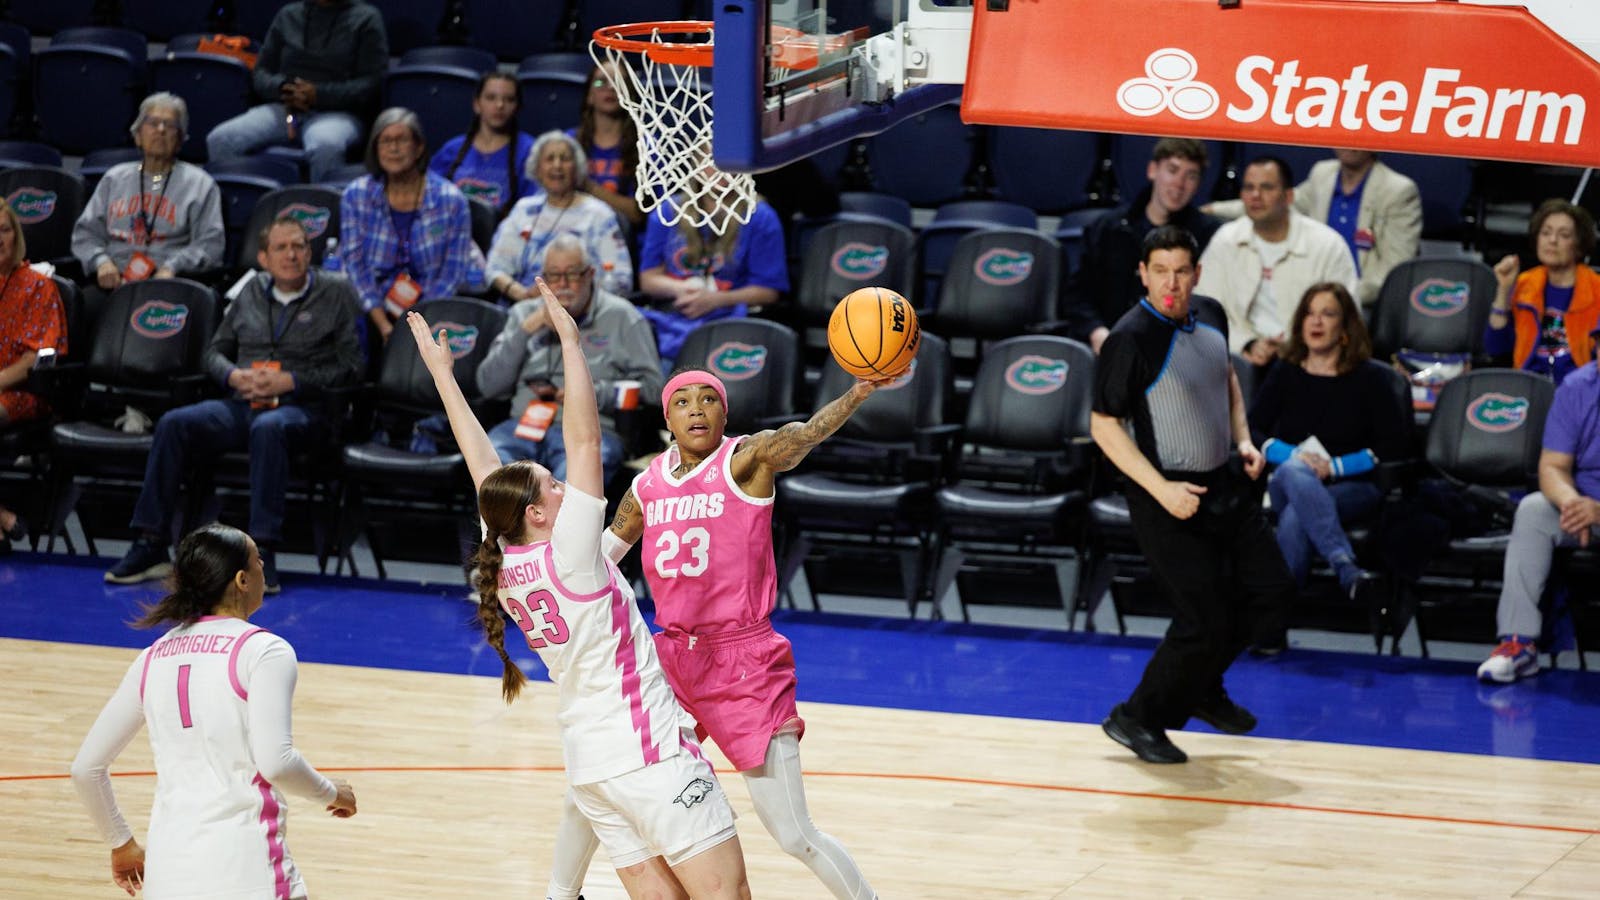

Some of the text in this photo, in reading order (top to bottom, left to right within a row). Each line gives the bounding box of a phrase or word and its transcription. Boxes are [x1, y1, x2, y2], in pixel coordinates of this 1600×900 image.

[646, 492, 725, 527] GATORS
[655, 526, 711, 579] 23
[506, 589, 570, 649] 23
[153, 634, 235, 659] RODRIGUEZ
[177, 664, 193, 729] 1
